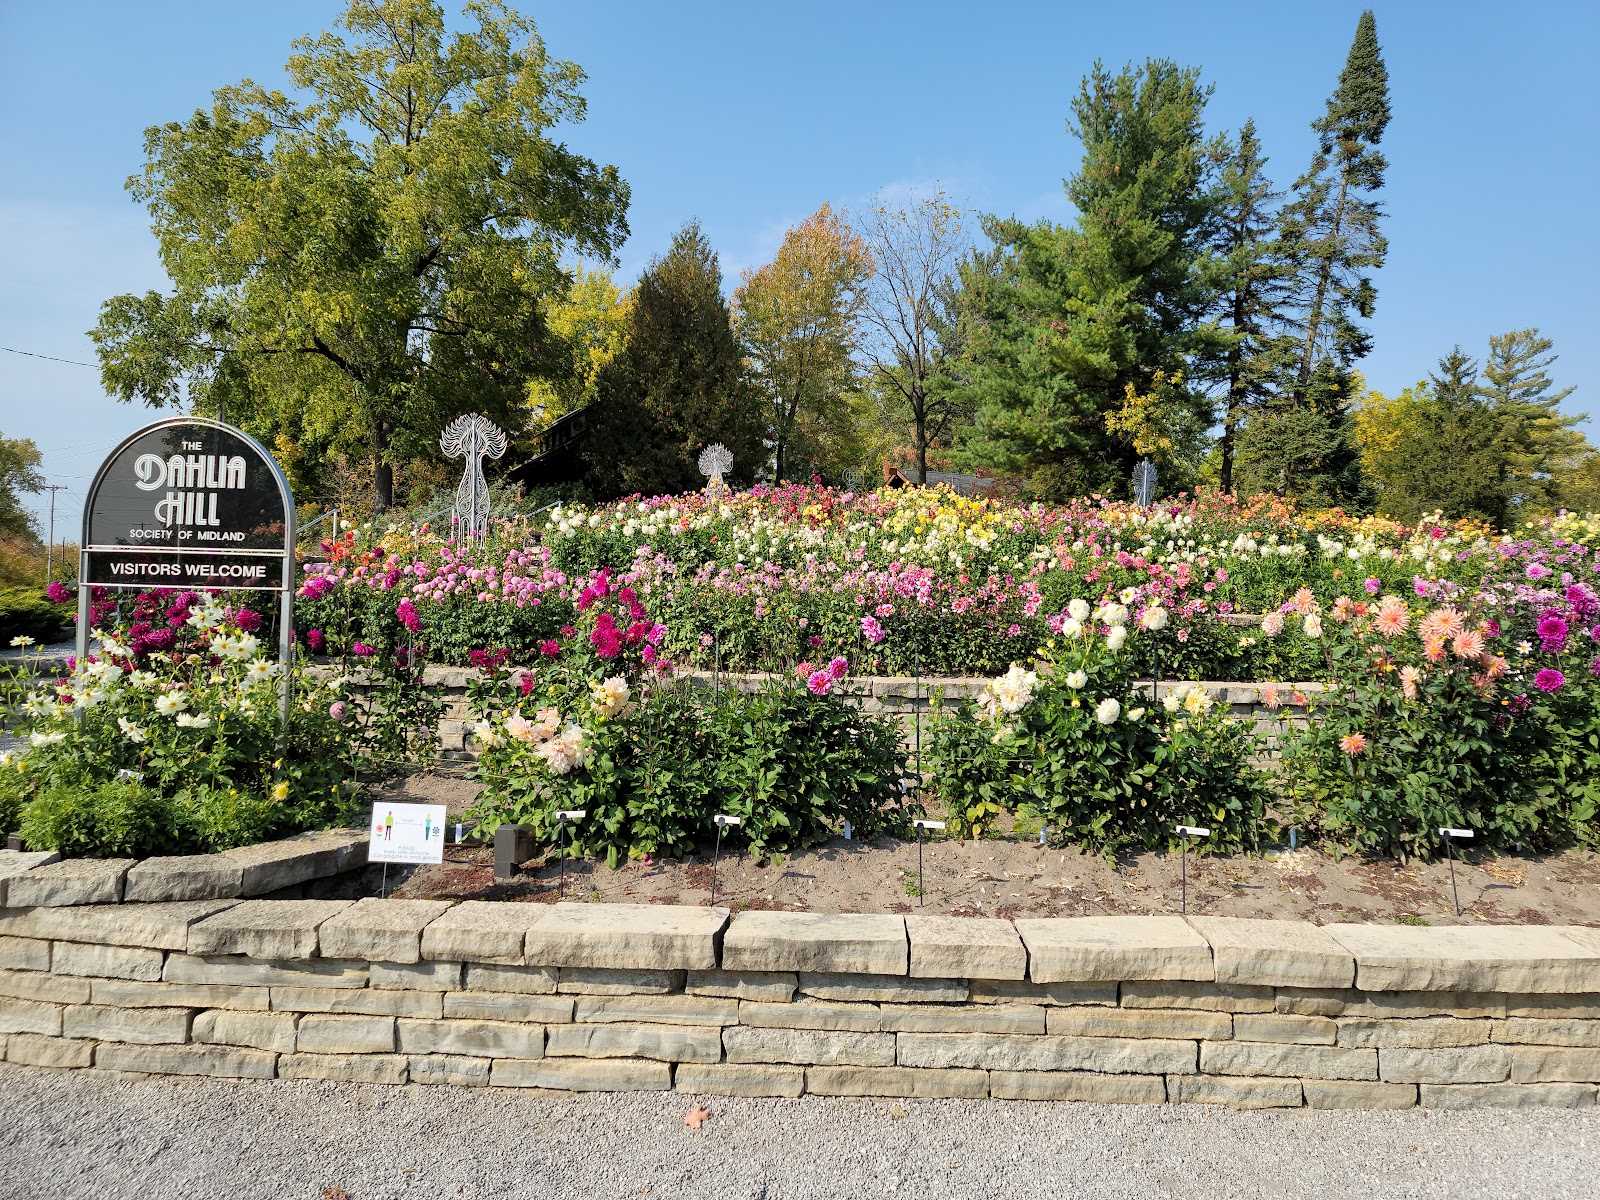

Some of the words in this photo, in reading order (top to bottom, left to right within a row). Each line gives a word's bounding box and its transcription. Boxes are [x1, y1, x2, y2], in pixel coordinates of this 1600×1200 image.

[181, 441, 202, 451] THE
[134, 453, 247, 491] DAHLIA
[154, 491, 220, 528] HILL
[130, 529, 173, 539] SOCIETY
[178, 530, 193, 540] OF
[197, 531, 245, 541] MIDLAND
[110, 562, 181, 576] VISITORS
[185, 564, 266, 578] WELCOME
